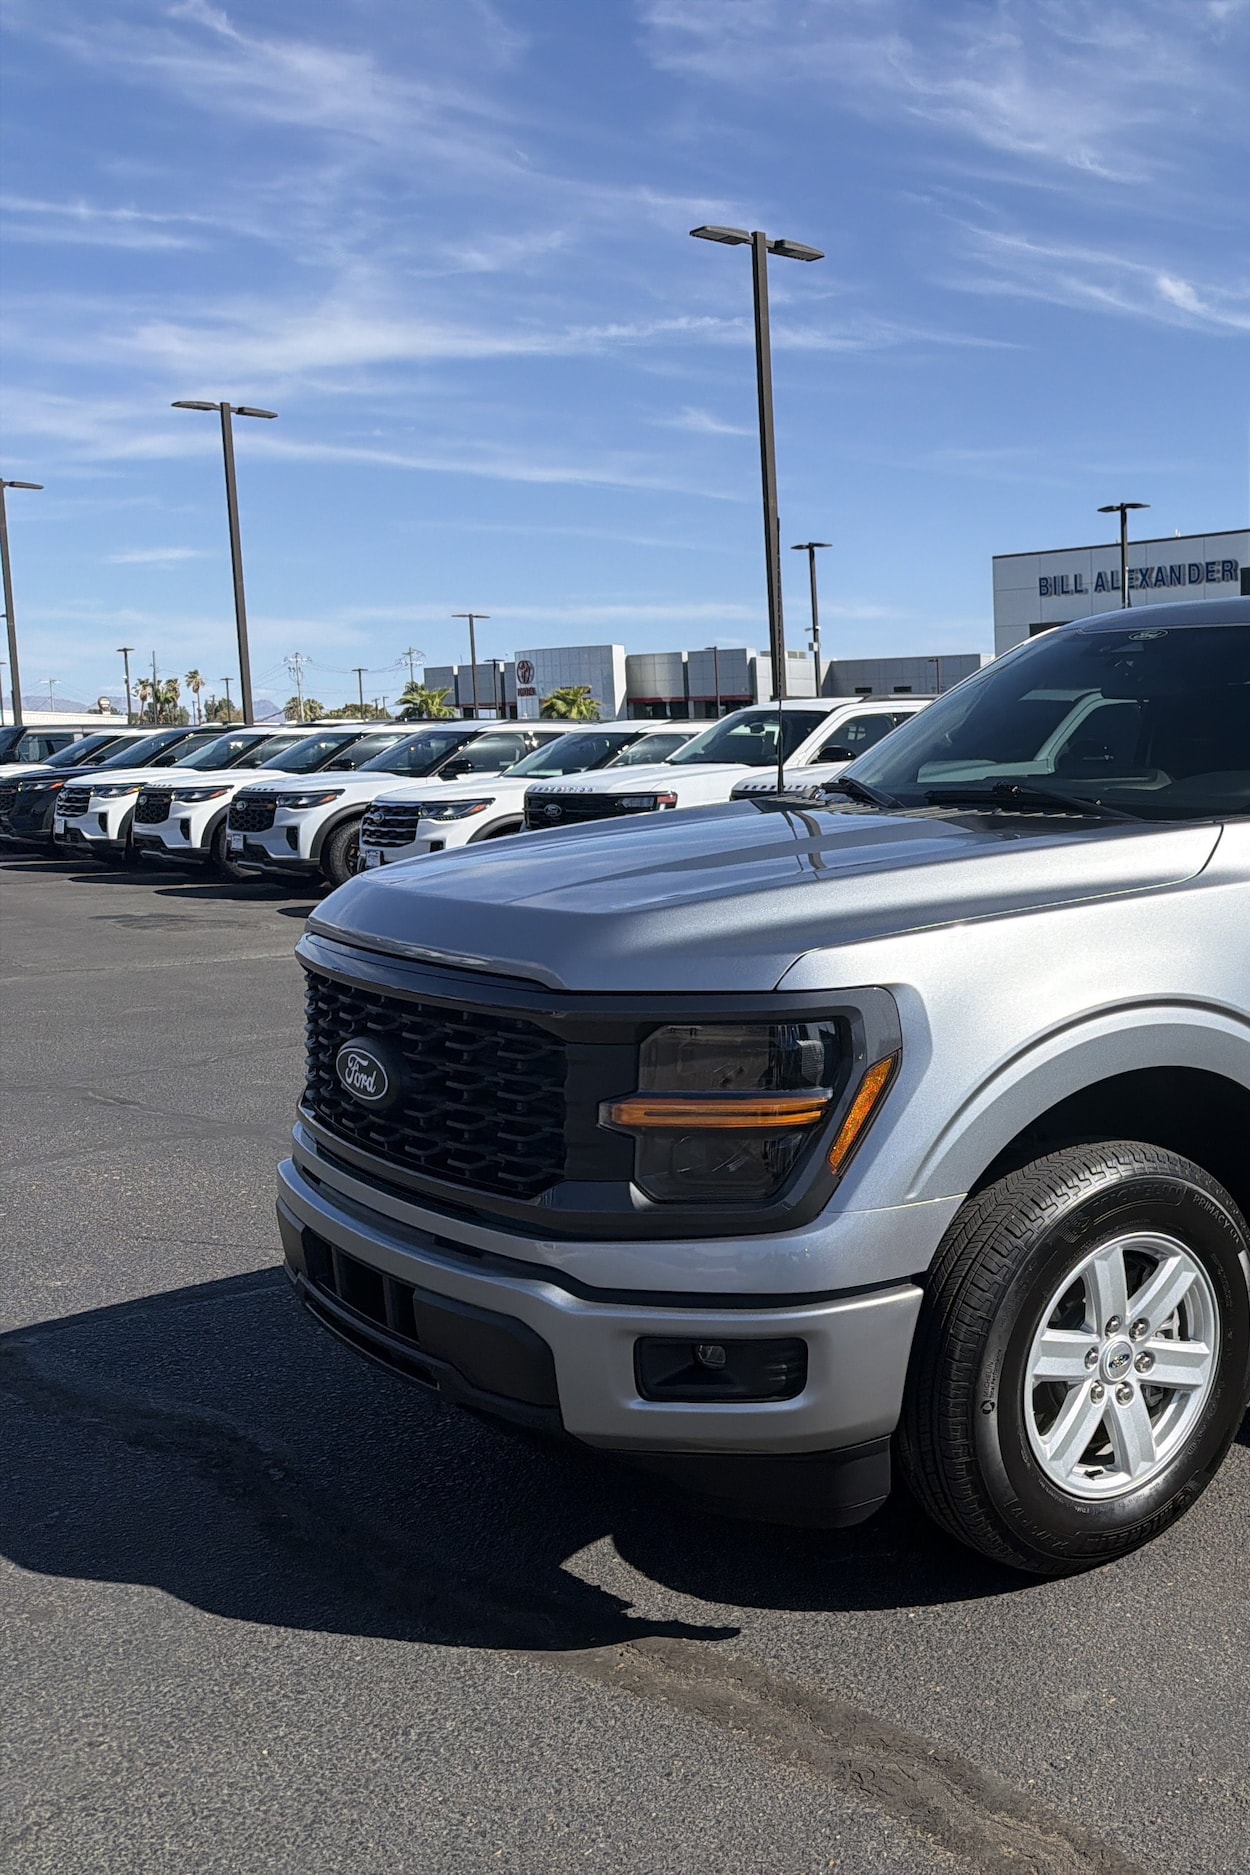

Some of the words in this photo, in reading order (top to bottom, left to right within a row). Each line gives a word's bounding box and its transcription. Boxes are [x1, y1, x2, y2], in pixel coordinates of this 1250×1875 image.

[1039, 573, 1086, 597] BILL
[1094, 559, 1239, 593] ALEXANDER
[345, 1054, 377, 1093] Ford
[1192, 1194, 1231, 1229] PRIMACY
[983, 1360, 993, 1398] MICHELIN
